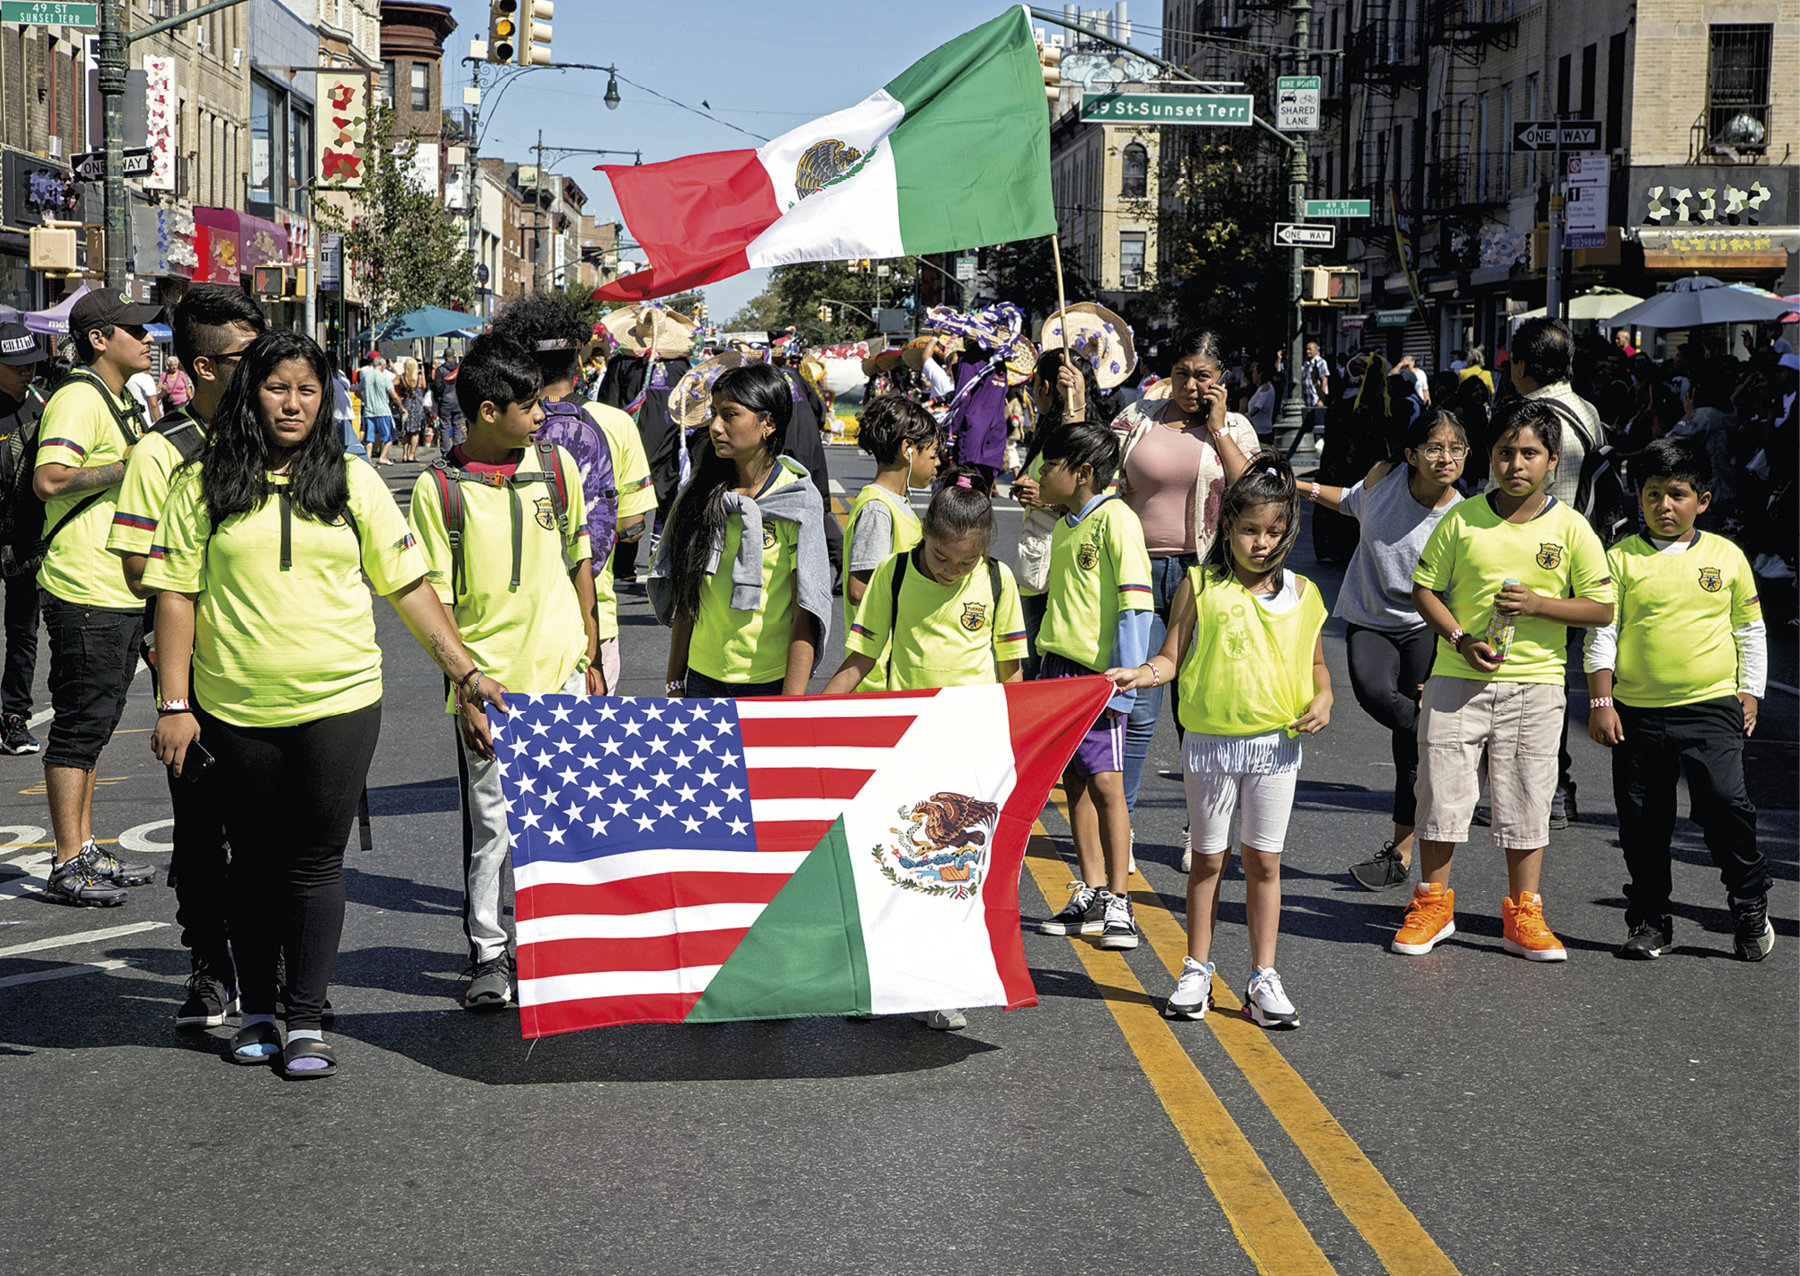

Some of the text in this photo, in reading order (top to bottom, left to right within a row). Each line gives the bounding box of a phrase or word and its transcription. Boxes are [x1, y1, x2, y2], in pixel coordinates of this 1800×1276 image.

[32, 3, 67, 14] 49 ST
[20, 12, 80, 24] SUNSET TERR
[1281, 80, 1317, 88] BIKE ROUTE
[1087, 101, 1245, 118] 49 St-Sunset Terr
[1281, 106, 1316, 115] SHARED
[1286, 116, 1309, 126] LANE
[1526, 130, 1590, 143] ONE WAY
[1571, 188, 1577, 201] 1
[1285, 230, 1327, 240] ONE WAY
